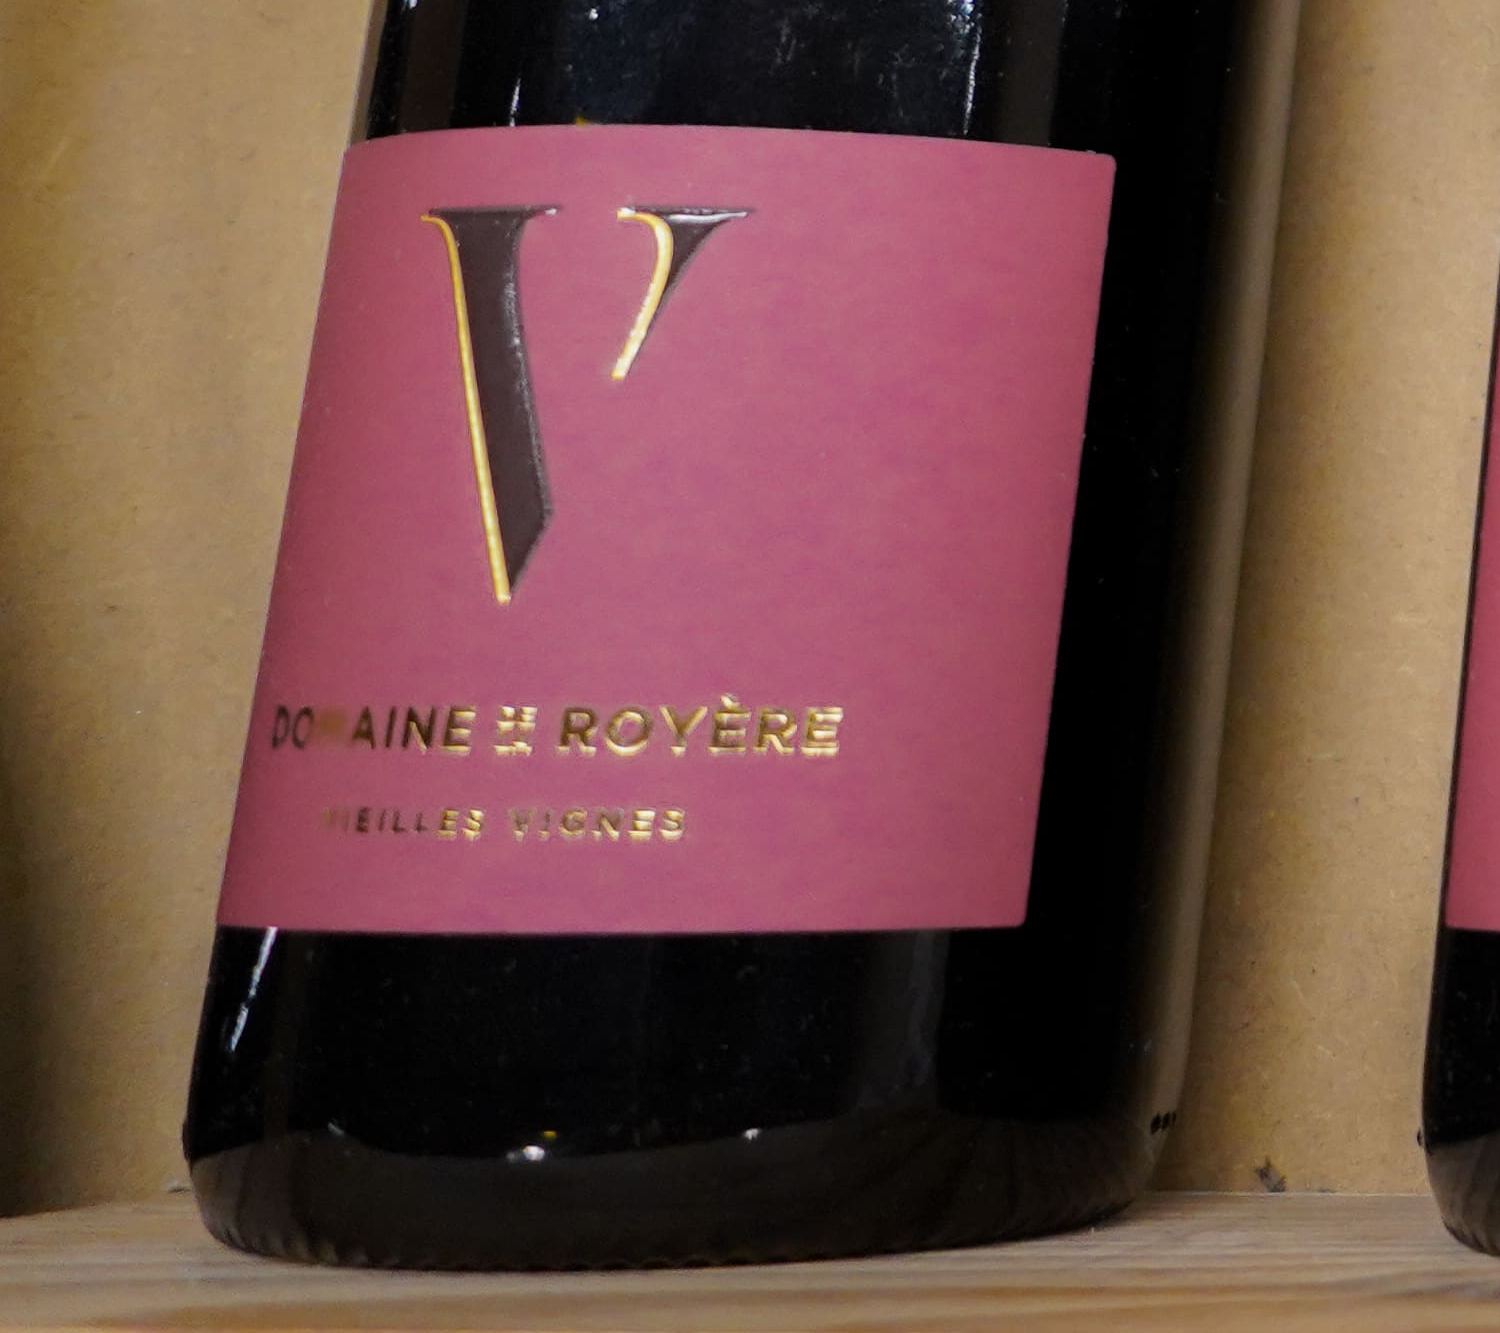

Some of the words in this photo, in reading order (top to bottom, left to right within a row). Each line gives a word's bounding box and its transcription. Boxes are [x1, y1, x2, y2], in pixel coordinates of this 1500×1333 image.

[420, 203, 757, 605] V
[271, 703, 478, 757] DOAINE
[557, 693, 846, 757] ROYÈRE
[508, 805, 687, 841] VIGNES
